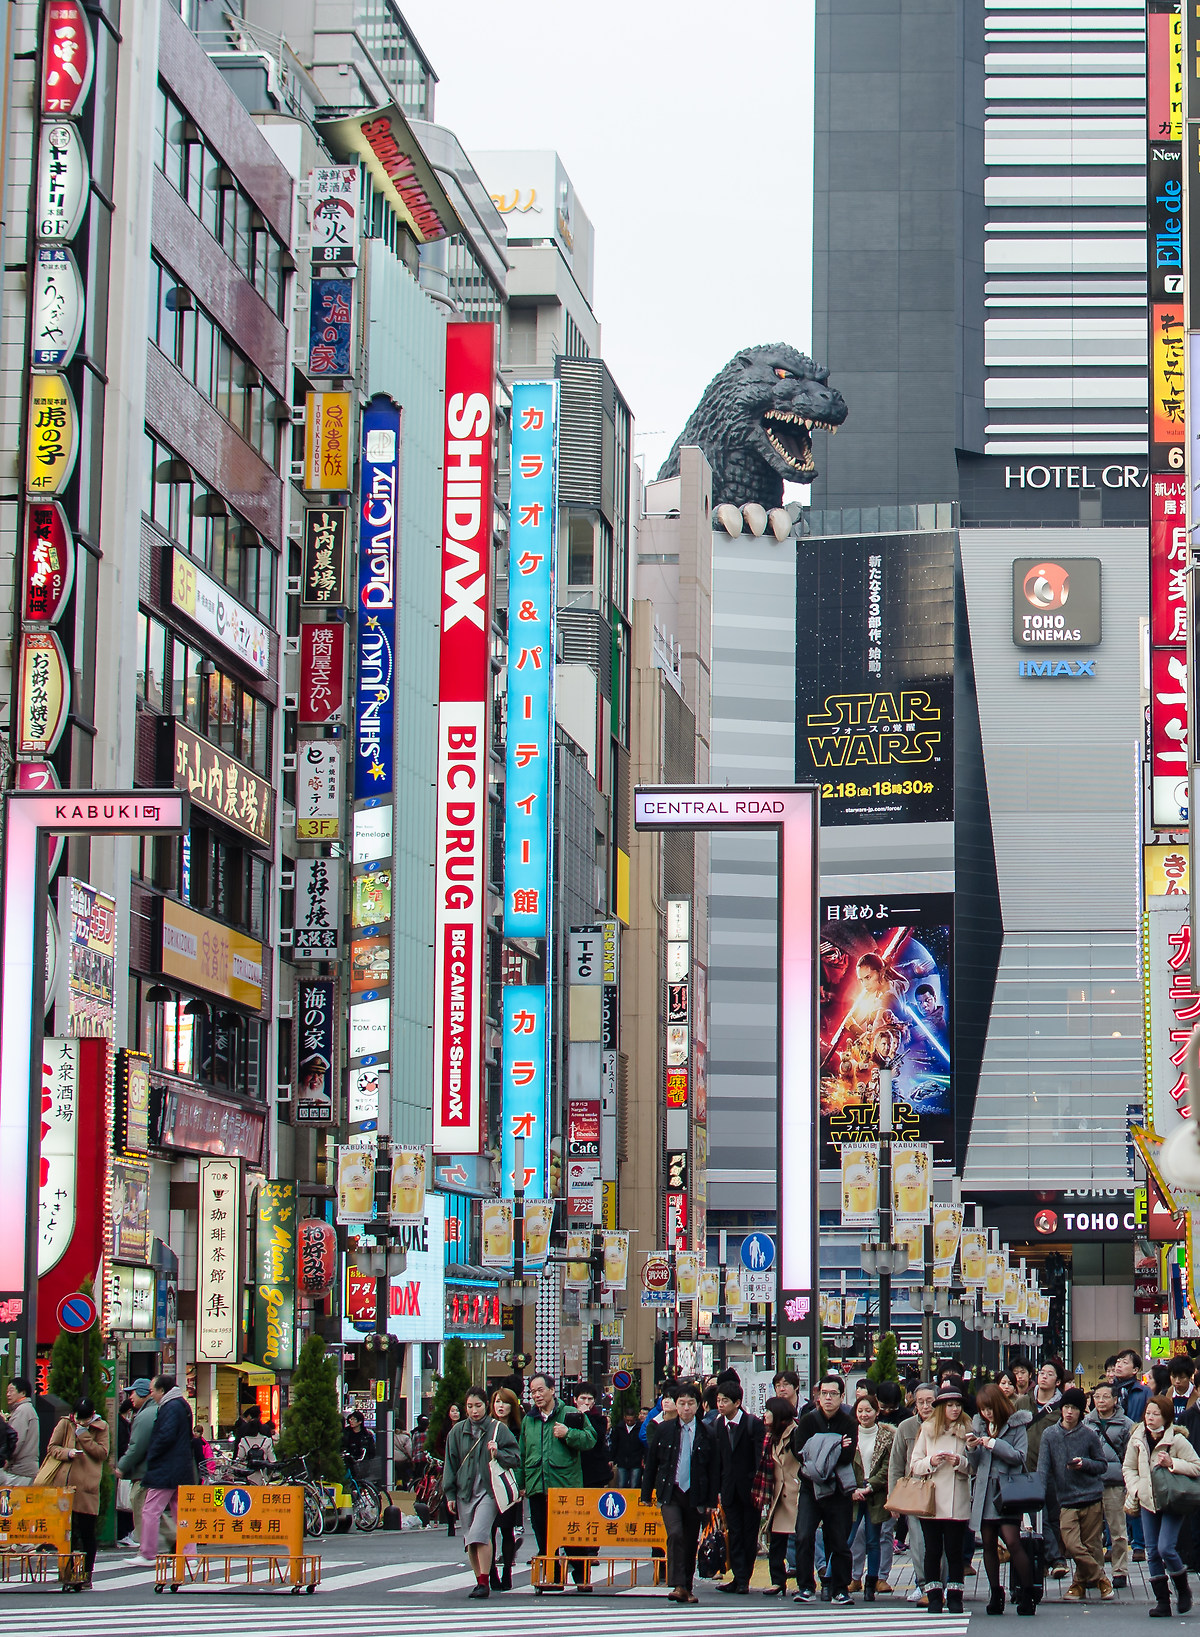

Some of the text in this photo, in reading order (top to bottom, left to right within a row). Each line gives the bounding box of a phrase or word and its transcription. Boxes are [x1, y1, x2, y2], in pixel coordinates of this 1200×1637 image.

[47, 99, 71, 110] 7F
[1152, 149, 1181, 161] New
[318, 169, 341, 181] 海鮮
[318, 182, 352, 193] 居酒屋
[41, 219, 69, 235] 6F
[1156, 180, 1182, 268] Elle de
[40, 250, 65, 261] 酒処
[323, 248, 341, 261] 8F
[1168, 278, 1181, 291] 7
[311, 295, 350, 373] 海の家
[41, 351, 59, 362] 5F
[35, 406, 67, 466] 虎の子
[31, 476, 52, 488] 4F
[1005, 466, 1096, 489] HOTEL
[444, 391, 490, 633] SHIDAX
[310, 512, 338, 591] 山内農場
[52, 573, 61, 600] 3F
[178, 563, 193, 605] 3F
[316, 590, 331, 601] 5F
[1022, 615, 1065, 629] TOHO
[1022, 629, 1081, 641] CINEMAS
[310, 628, 334, 713] 焼肉屋さかい
[1018, 660, 1096, 677] IMAX
[30, 652, 50, 739] お好み焼き
[360, 633, 390, 758] SHINJUKU
[807, 691, 941, 726] STAR
[328, 714, 341, 722] 4F
[831, 723, 916, 735] フォースの覚醒
[176, 739, 189, 776] 5F
[808, 732, 941, 767] WARS
[189, 741, 259, 832] 山内農場
[644, 801, 785, 814] CENTRAL ROAD
[444, 725, 477, 911] BIC DRUG
[307, 820, 331, 835] 3F
[355, 831, 391, 839] Penelope
[359, 852, 370, 861] 7F
[305, 859, 331, 928] お好み焼
[297, 930, 335, 948] 大阪家
[577, 940, 594, 978] TFC
[303, 987, 326, 1050] 海の家
[448, 929, 466, 1121] BIC CAMERA SHIDAX
[55, 1042, 75, 1123] 大衆酒場
[668, 1075, 686, 1103] 麻雀
[511, 1009, 537, 1188] カラオケ
[569, 1141, 598, 1154] Cafe
[259, 1184, 292, 1198] パスタ
[1064, 1213, 1119, 1230] TOHO
[210, 1208, 227, 1284] 珈琲茶館
[271, 1225, 292, 1284] Miami
[302, 1226, 326, 1291] お好み焼
[648, 1270, 668, 1280] 消火栓
[205, 1292, 230, 1318] 集
[390, 1281, 421, 1316] IDAX
[210, 1338, 224, 1349] 2F
[186, 1493, 211, 1504] 平日
[262, 1493, 291, 1504] 日祭日
[558, 1495, 585, 1506] 平日
[195, 1518, 281, 1533] 歩行者専用
[567, 1521, 657, 1536] 歩行者専用
